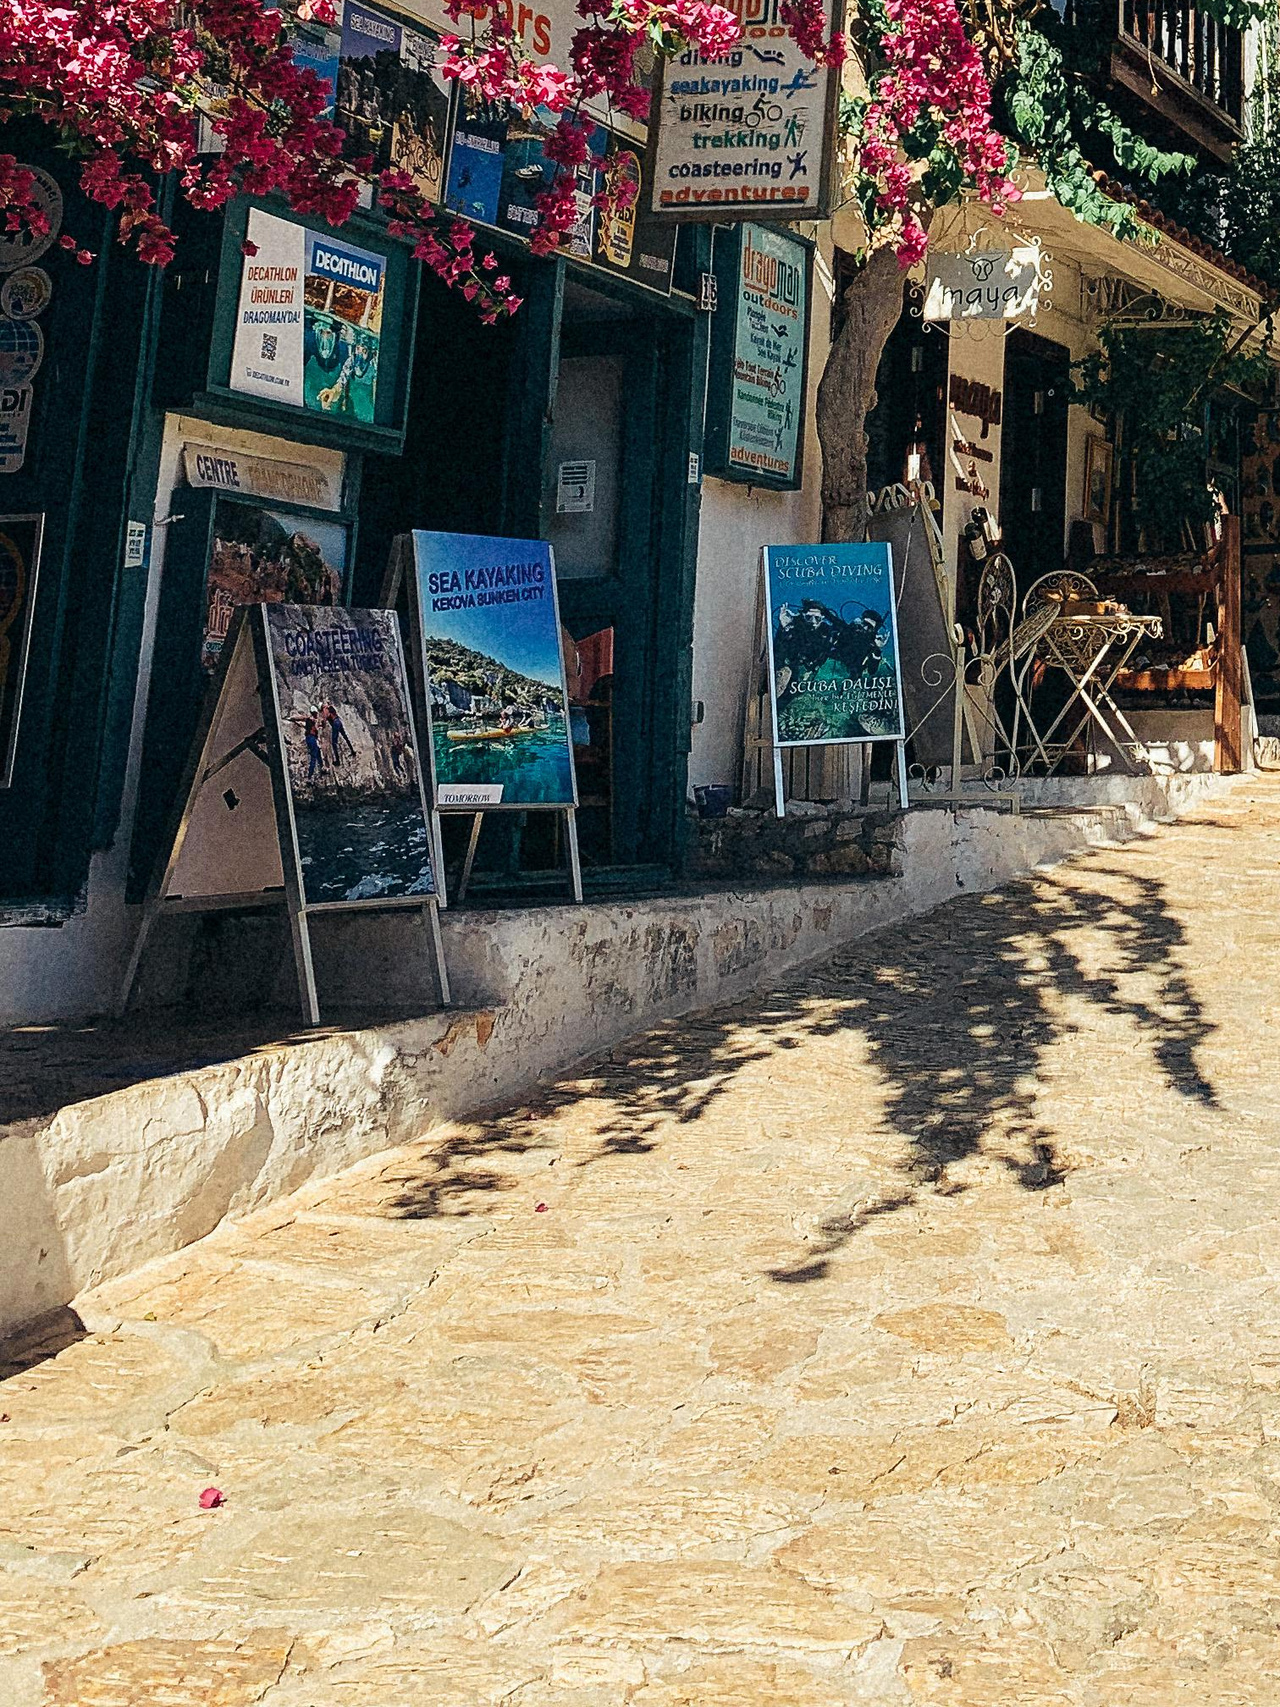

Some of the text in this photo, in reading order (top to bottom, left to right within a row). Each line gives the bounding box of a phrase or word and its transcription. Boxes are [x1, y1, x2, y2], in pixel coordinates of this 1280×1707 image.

[670, 74, 780, 97] seakayaking
[680, 104, 744, 124] biking
[692, 130, 781, 150] trekking
[668, 158, 783, 179] coasteering
[660, 185, 810, 203] adventures
[248, 266, 298, 282] DECATHLON
[316, 249, 378, 286] DECATHLON
[743, 230, 800, 307] dragoman
[251, 286, 294, 304] ÜRÜNLERİ
[743, 291, 798, 320] outdoors
[941, 285, 1019, 311] maya
[243, 310, 300, 324] DRAGOMAN'DA!
[731, 446, 789, 472] adventures
[197, 454, 240, 487] CENTRE
[775, 555, 837, 568] DISCOVER
[778, 564, 883, 580] SCUBA DIVING
[428, 563, 544, 595] SEA KAYAKING
[432, 585, 544, 612] KEKOVA SUNKEN CITY
[285, 628, 383, 657] COASTEERING
[790, 676, 892, 694] SCUBA DALIŞI
[444, 794, 490, 803] TOMORROW
